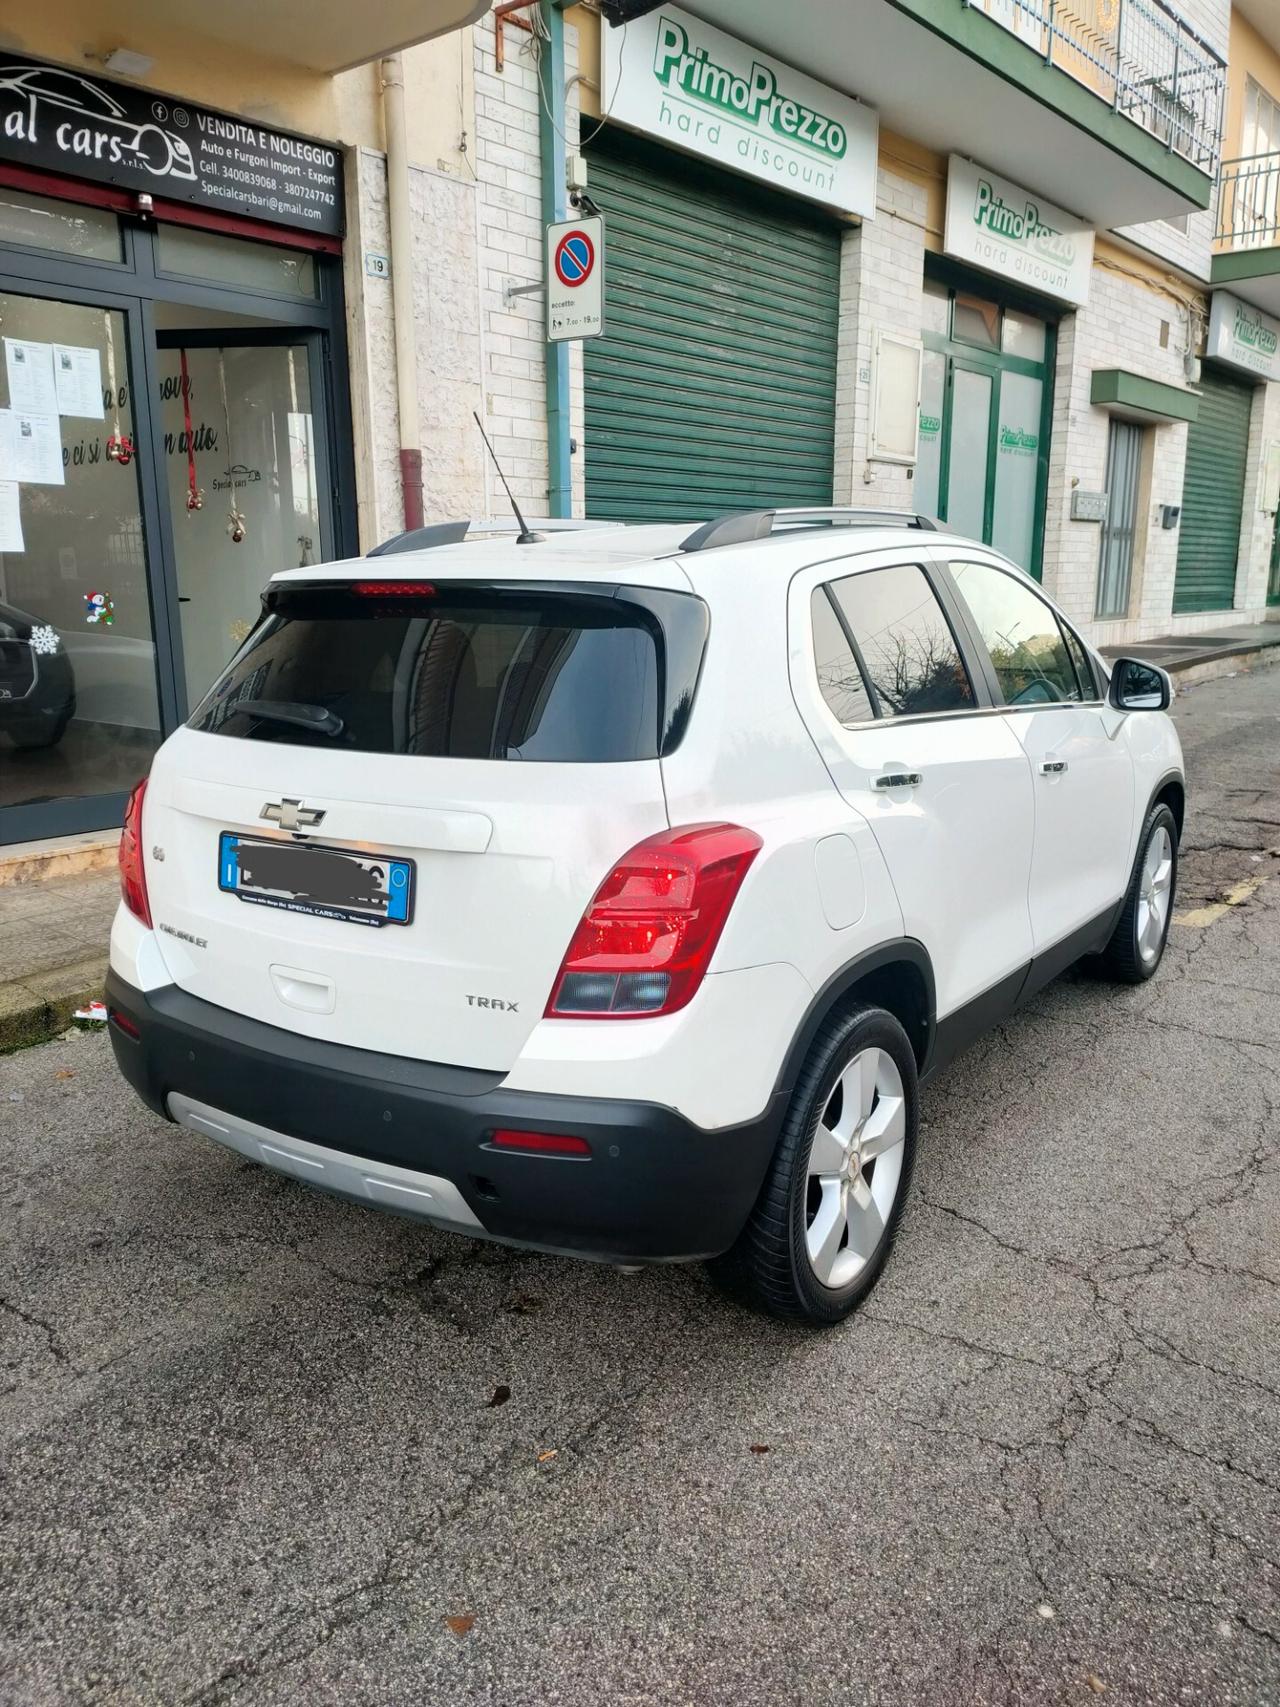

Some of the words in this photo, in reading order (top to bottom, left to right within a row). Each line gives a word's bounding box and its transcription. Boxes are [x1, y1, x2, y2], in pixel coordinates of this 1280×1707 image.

[653, 15, 848, 162] PrimoPrezzo
[56, 122, 122, 163] cars
[196, 112, 257, 147] VENDITA
[259, 130, 268, 150] E
[270, 134, 335, 168] NOLEGGIO
[200, 139, 224, 157] Auto
[226, 148, 232, 158] e
[234, 148, 269, 169] Furgoni
[270, 159, 301, 177] Import
[307, 168, 336, 186] Export
[658, 101, 721, 145] hard
[737, 136, 835, 192] discount
[199, 160, 220, 176] Cell.
[222, 165, 277, 191] 3400839068
[284, 182, 335, 206] 3807247742
[201, 180, 322, 220] Specialcarsbari@gmail.com
[973, 178, 1077, 267] PrimoPrezzo
[373, 260, 384, 272] 19
[974, 239, 1007, 264] hard
[1014, 256, 1069, 289] discount
[73, 437, 85, 466] ci
[287, 902, 314, 914] SPECIAL
[314, 908, 334, 918] CARS
[465, 994, 520, 1014] TRAX
